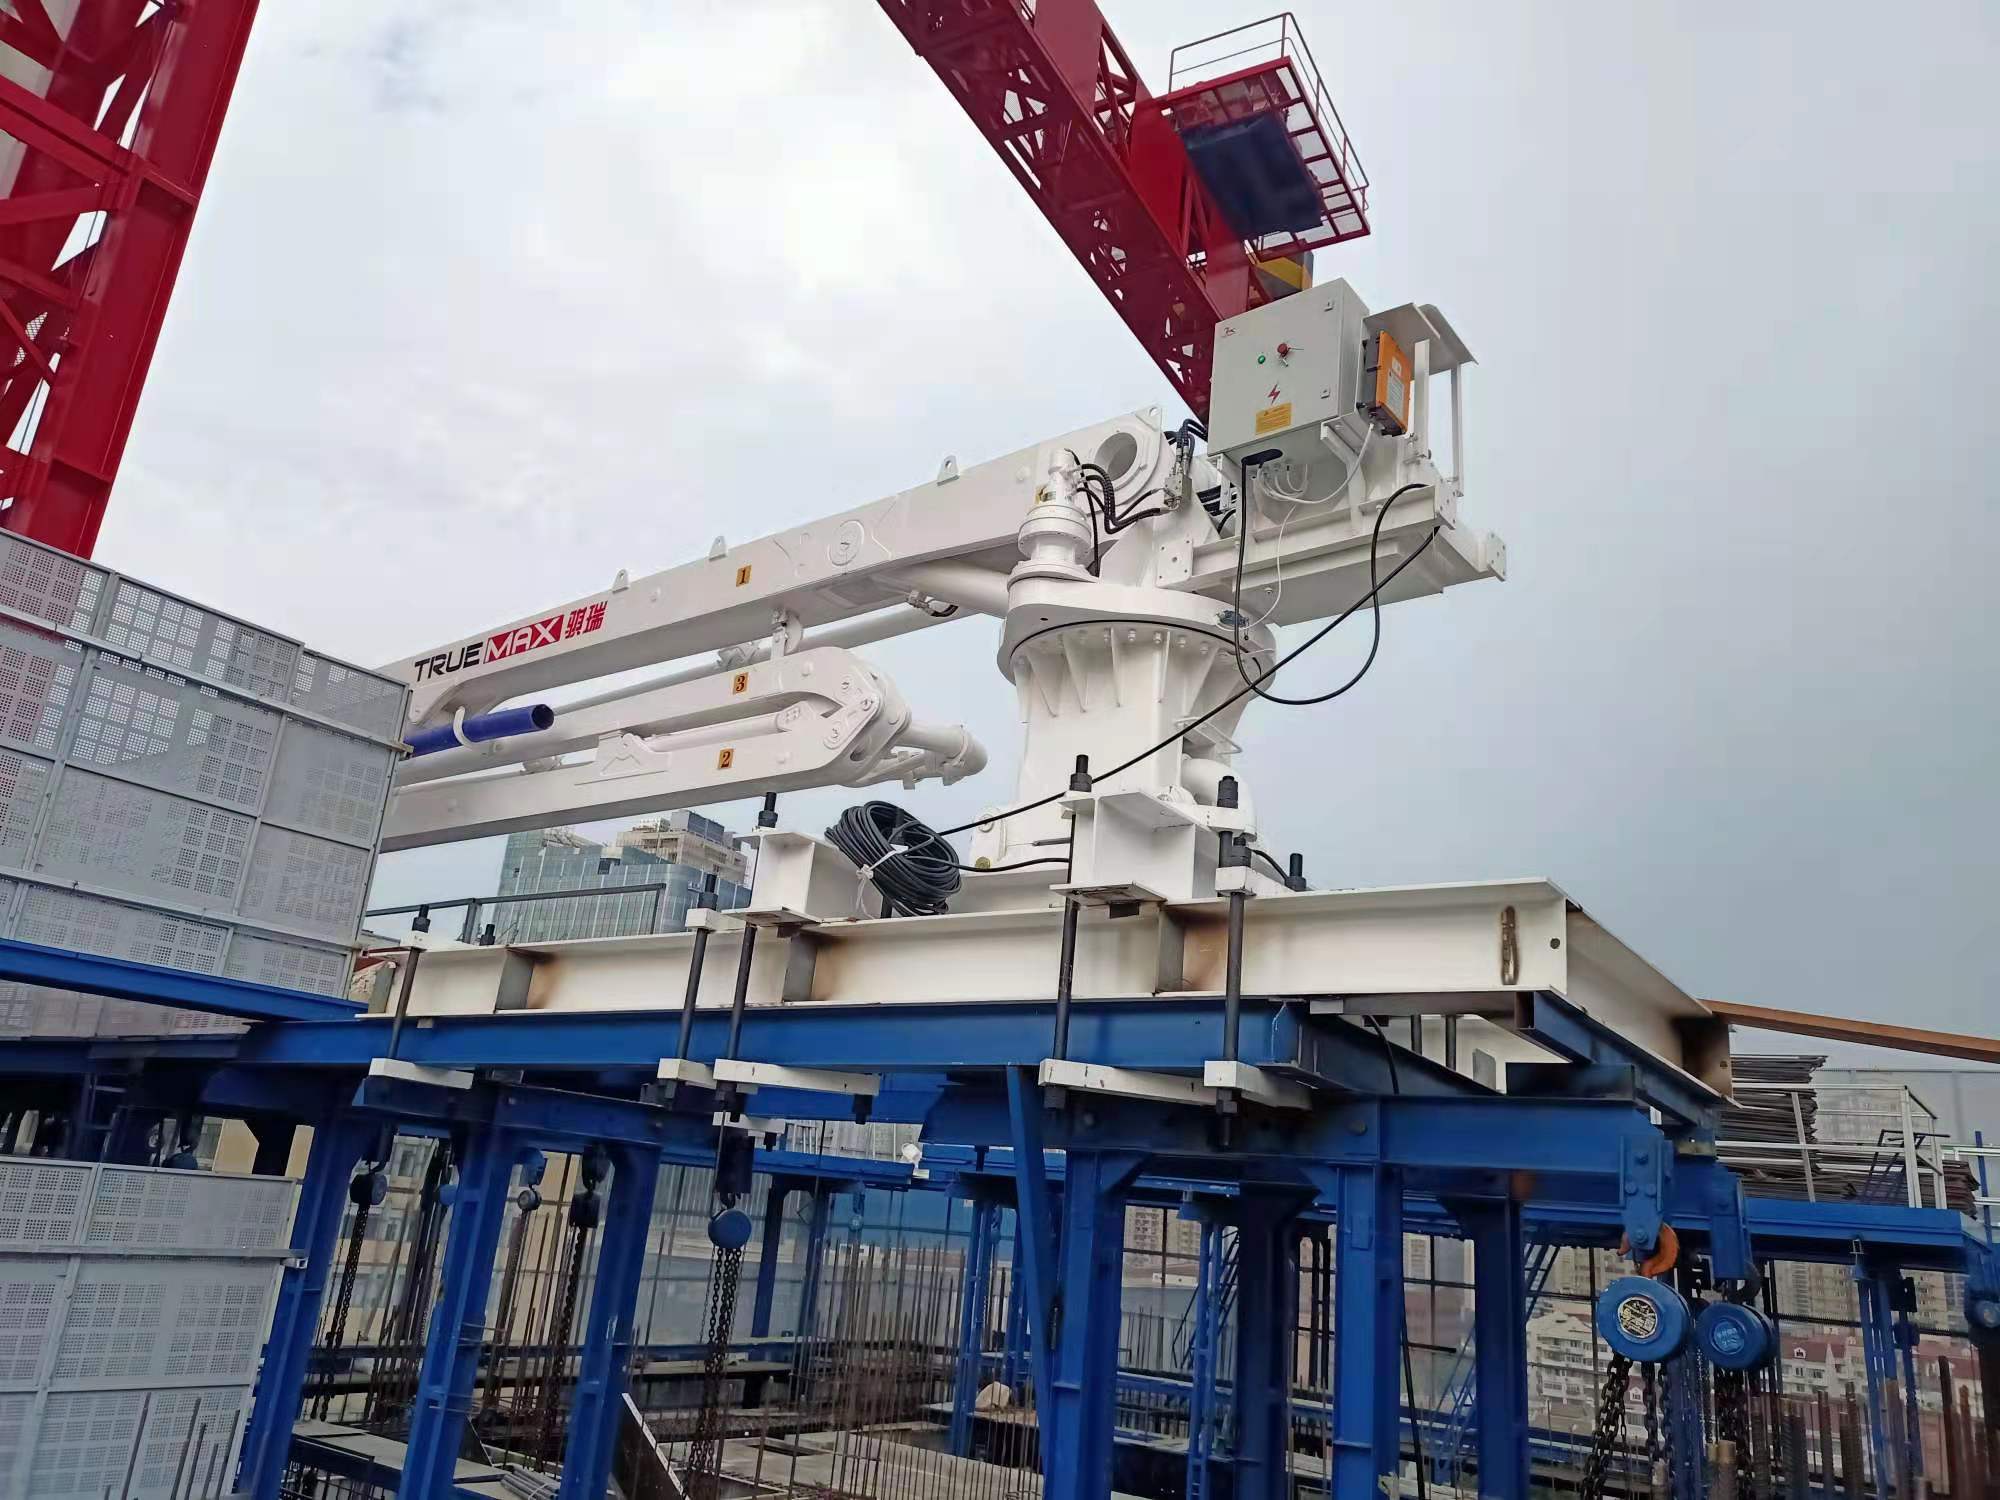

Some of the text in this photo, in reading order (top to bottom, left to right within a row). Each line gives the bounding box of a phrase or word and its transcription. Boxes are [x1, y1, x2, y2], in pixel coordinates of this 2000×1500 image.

[738, 567, 748, 586] 1
[565, 601, 608, 639] 骐瑞
[735, 674, 746, 693] 3
[720, 750, 732, 769] 2
